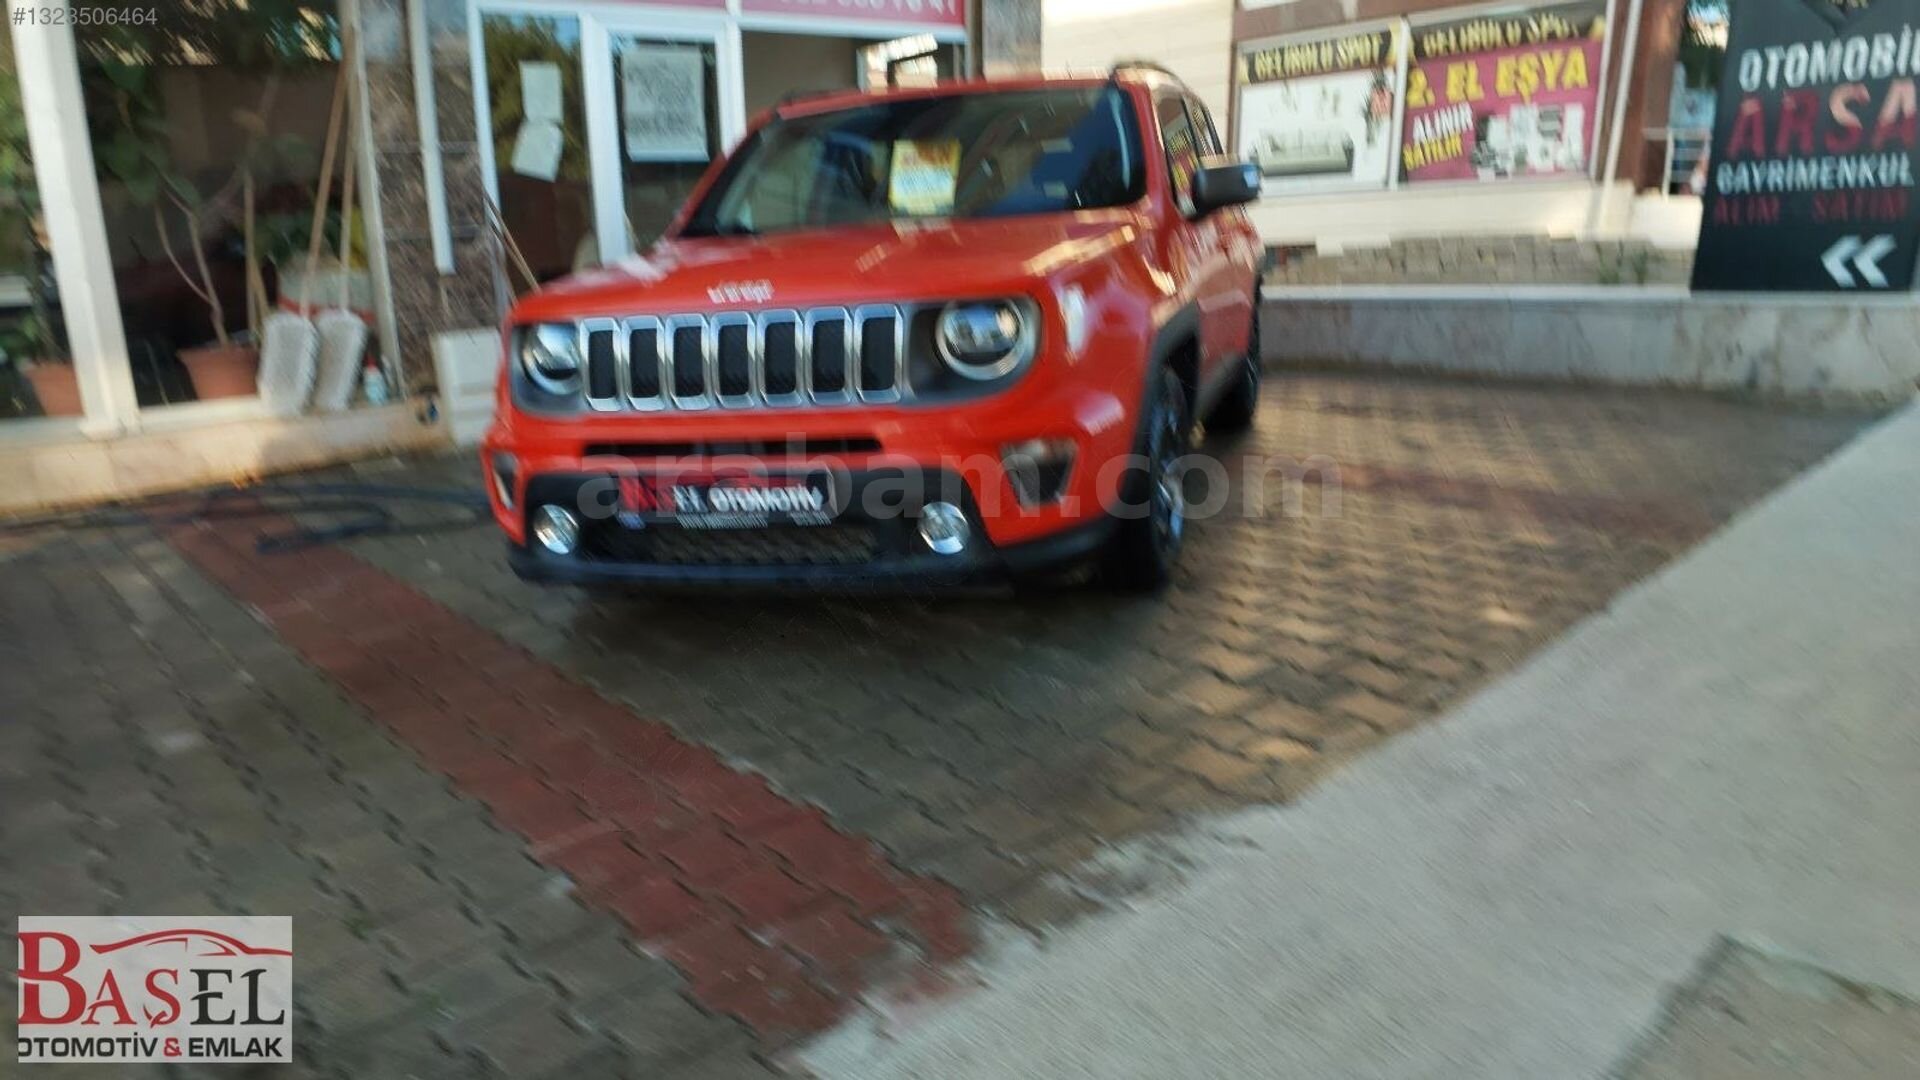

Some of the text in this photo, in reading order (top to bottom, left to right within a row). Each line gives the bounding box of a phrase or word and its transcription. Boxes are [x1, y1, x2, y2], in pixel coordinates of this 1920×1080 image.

[1336, 31, 1383, 71] SPOT
[1405, 46, 1588, 108] 2. EL EŞYA
[1412, 101, 1473, 144] ALINIR
[1726, 78, 1918, 159] ARSA
[1716, 151, 1915, 194] GAYRİMENKUL
